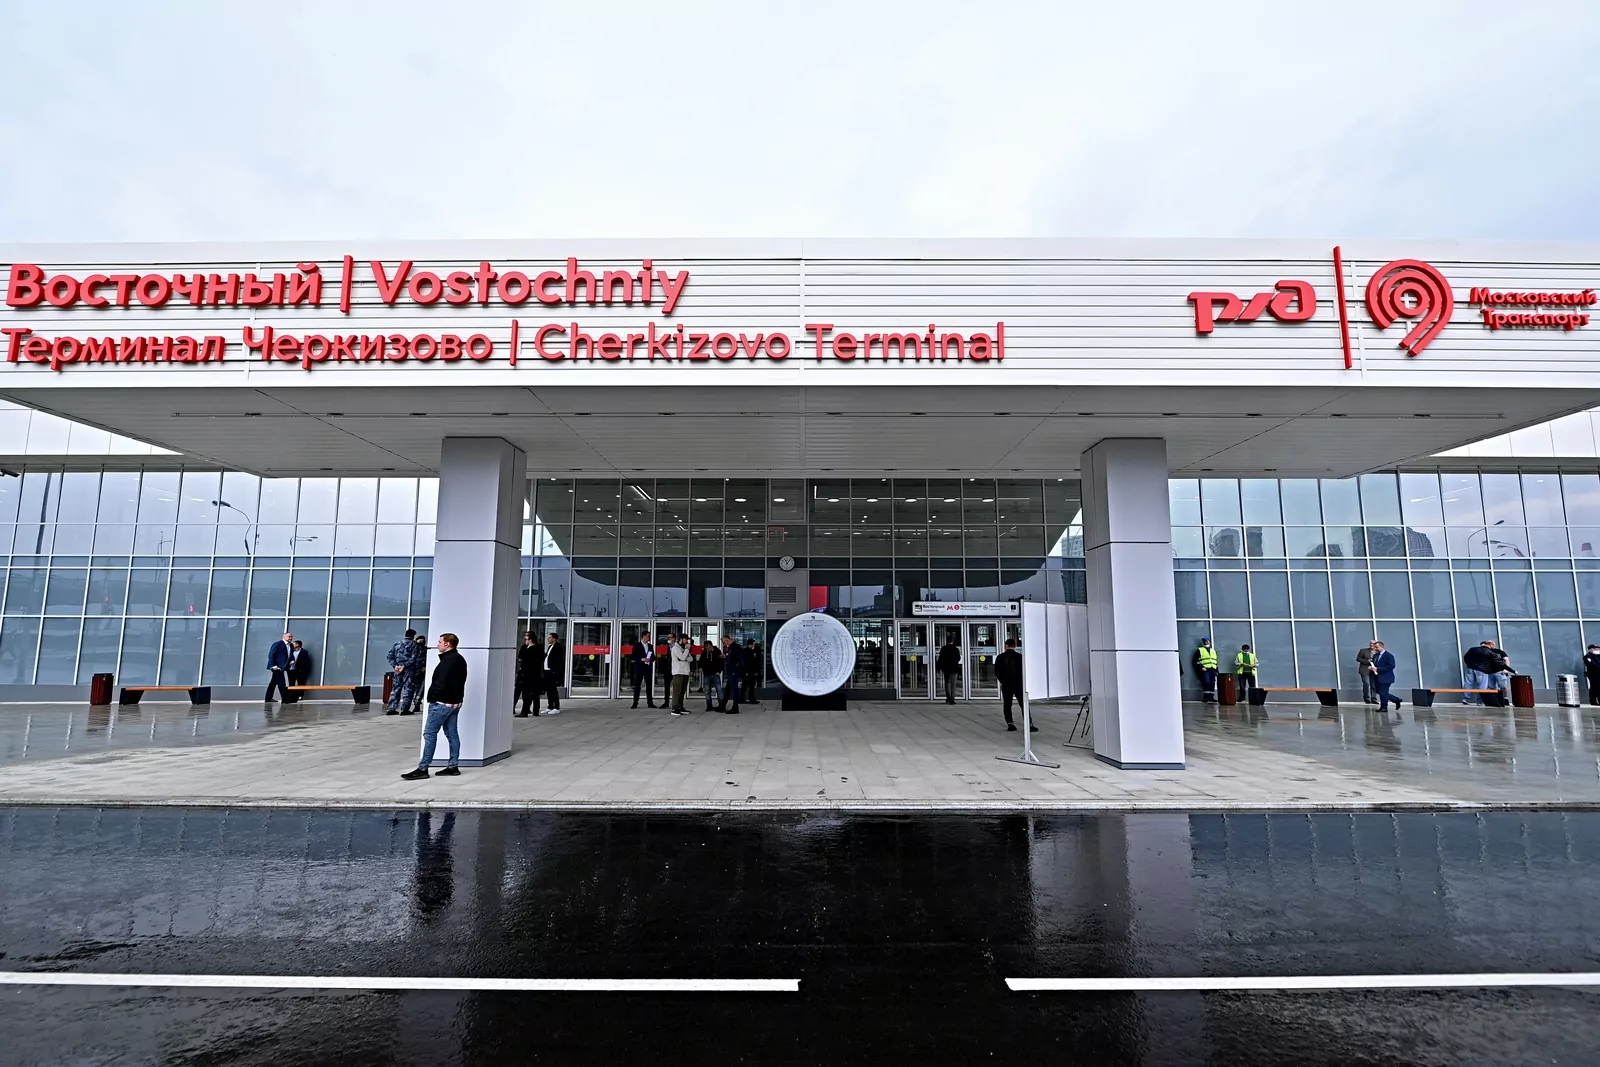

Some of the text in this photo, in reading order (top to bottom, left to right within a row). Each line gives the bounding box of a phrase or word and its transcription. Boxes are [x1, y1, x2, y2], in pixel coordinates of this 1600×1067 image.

[6, 262, 324, 308] Восточный
[369, 257, 689, 314] Vostochniy
[1469, 286, 1597, 305] Московский
[1481, 307, 1589, 330] Транспорт
[0, 325, 494, 371] Терминал Черкизово
[533, 321, 1006, 362] Cherkizovo Terminal
